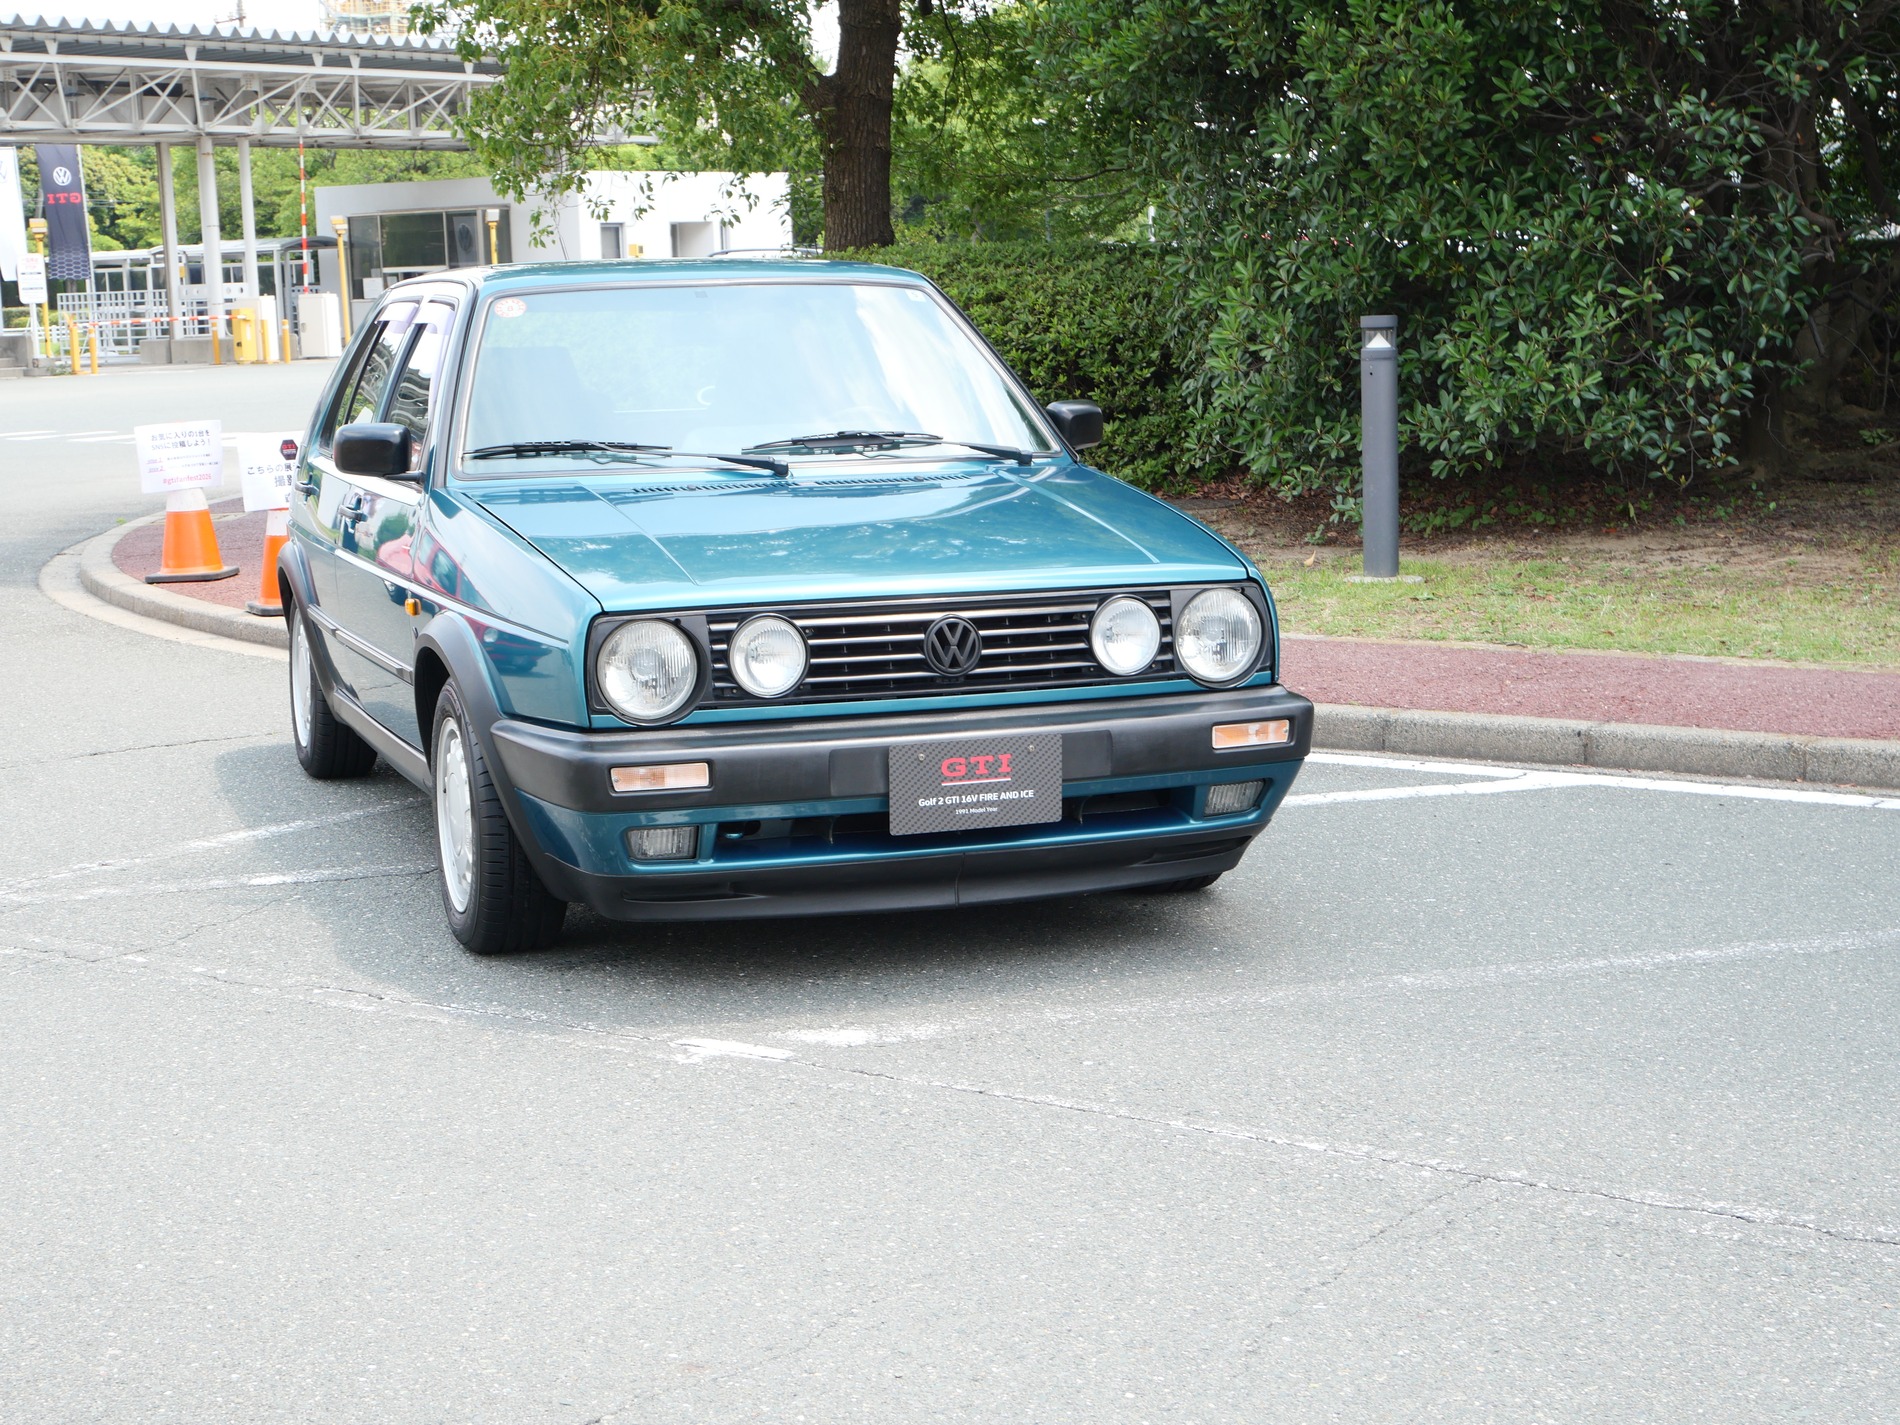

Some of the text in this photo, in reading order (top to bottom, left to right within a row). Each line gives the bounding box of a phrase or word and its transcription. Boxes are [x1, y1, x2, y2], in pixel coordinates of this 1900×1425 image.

[941, 754, 1012, 777] GTI
[918, 789, 1034, 807] Golf 2 GTI 16V FIRE AND ICE
